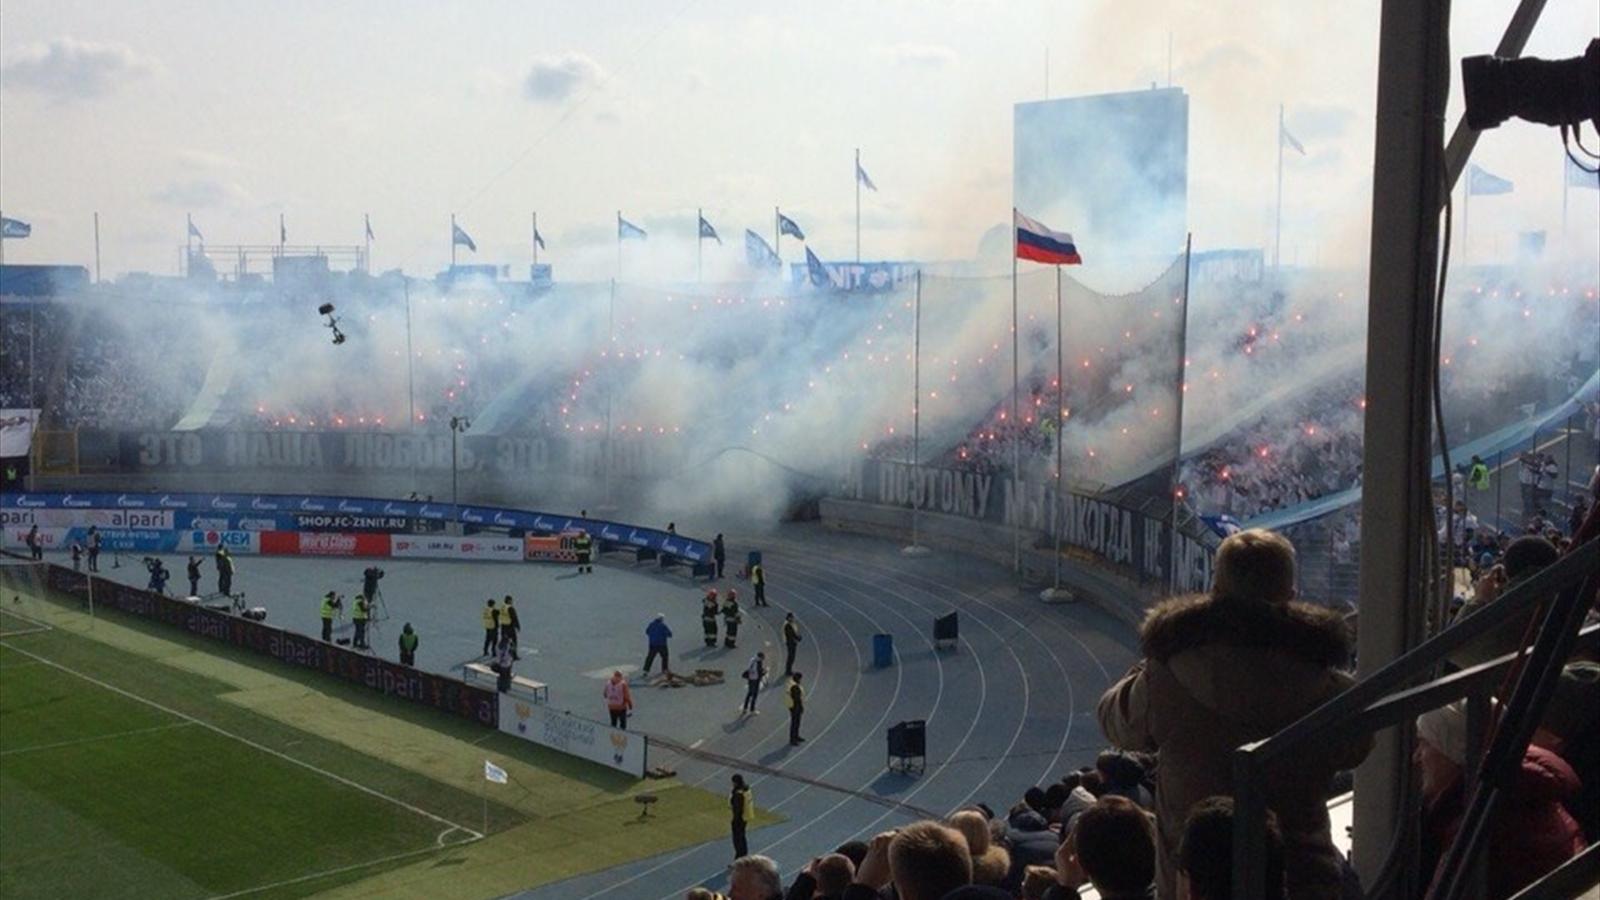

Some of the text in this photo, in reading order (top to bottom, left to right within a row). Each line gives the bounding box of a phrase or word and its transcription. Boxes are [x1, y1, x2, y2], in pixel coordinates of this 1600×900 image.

[139, 432, 202, 466] ЭТО
[879, 465, 992, 519] ПОЭТОМУ
[112, 509, 165, 529] alpari
[365, 662, 424, 700] alpari
